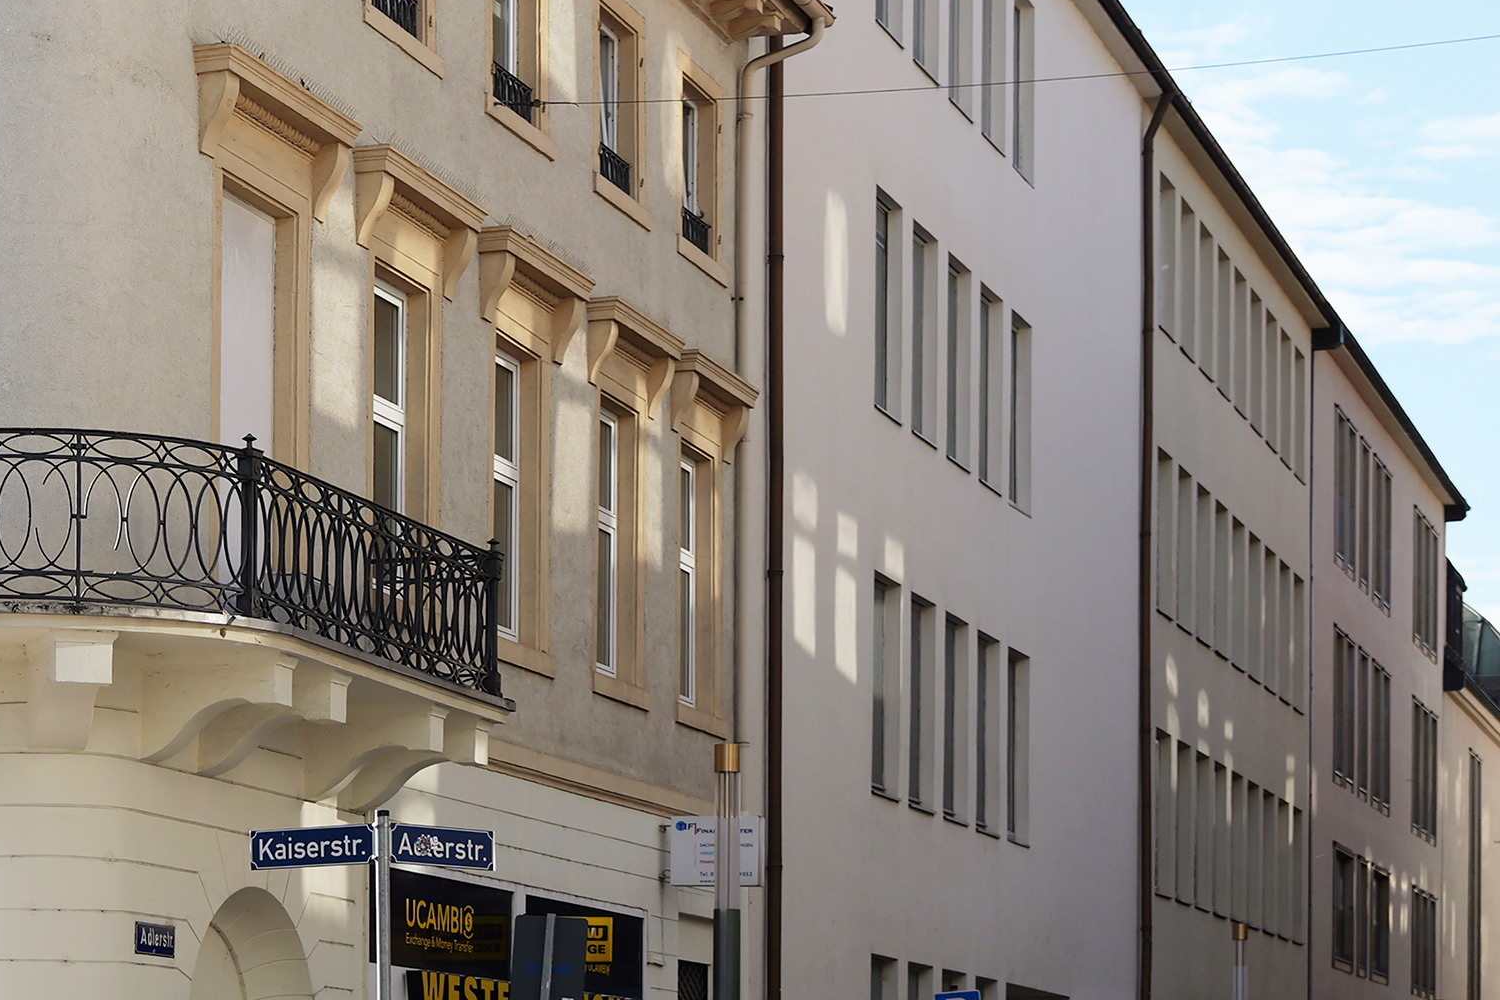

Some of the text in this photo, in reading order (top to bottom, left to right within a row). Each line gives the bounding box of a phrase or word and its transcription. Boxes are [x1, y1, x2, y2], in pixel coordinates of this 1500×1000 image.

[258, 835, 366, 861] Kaiserstr.
[398, 832, 488, 862] Aerstr.
[405, 932, 430, 950] Exchange
[435, 937, 453, 953] Money
[453, 939, 474, 953] Transfer
[422, 970, 510, 1000] WESTE
